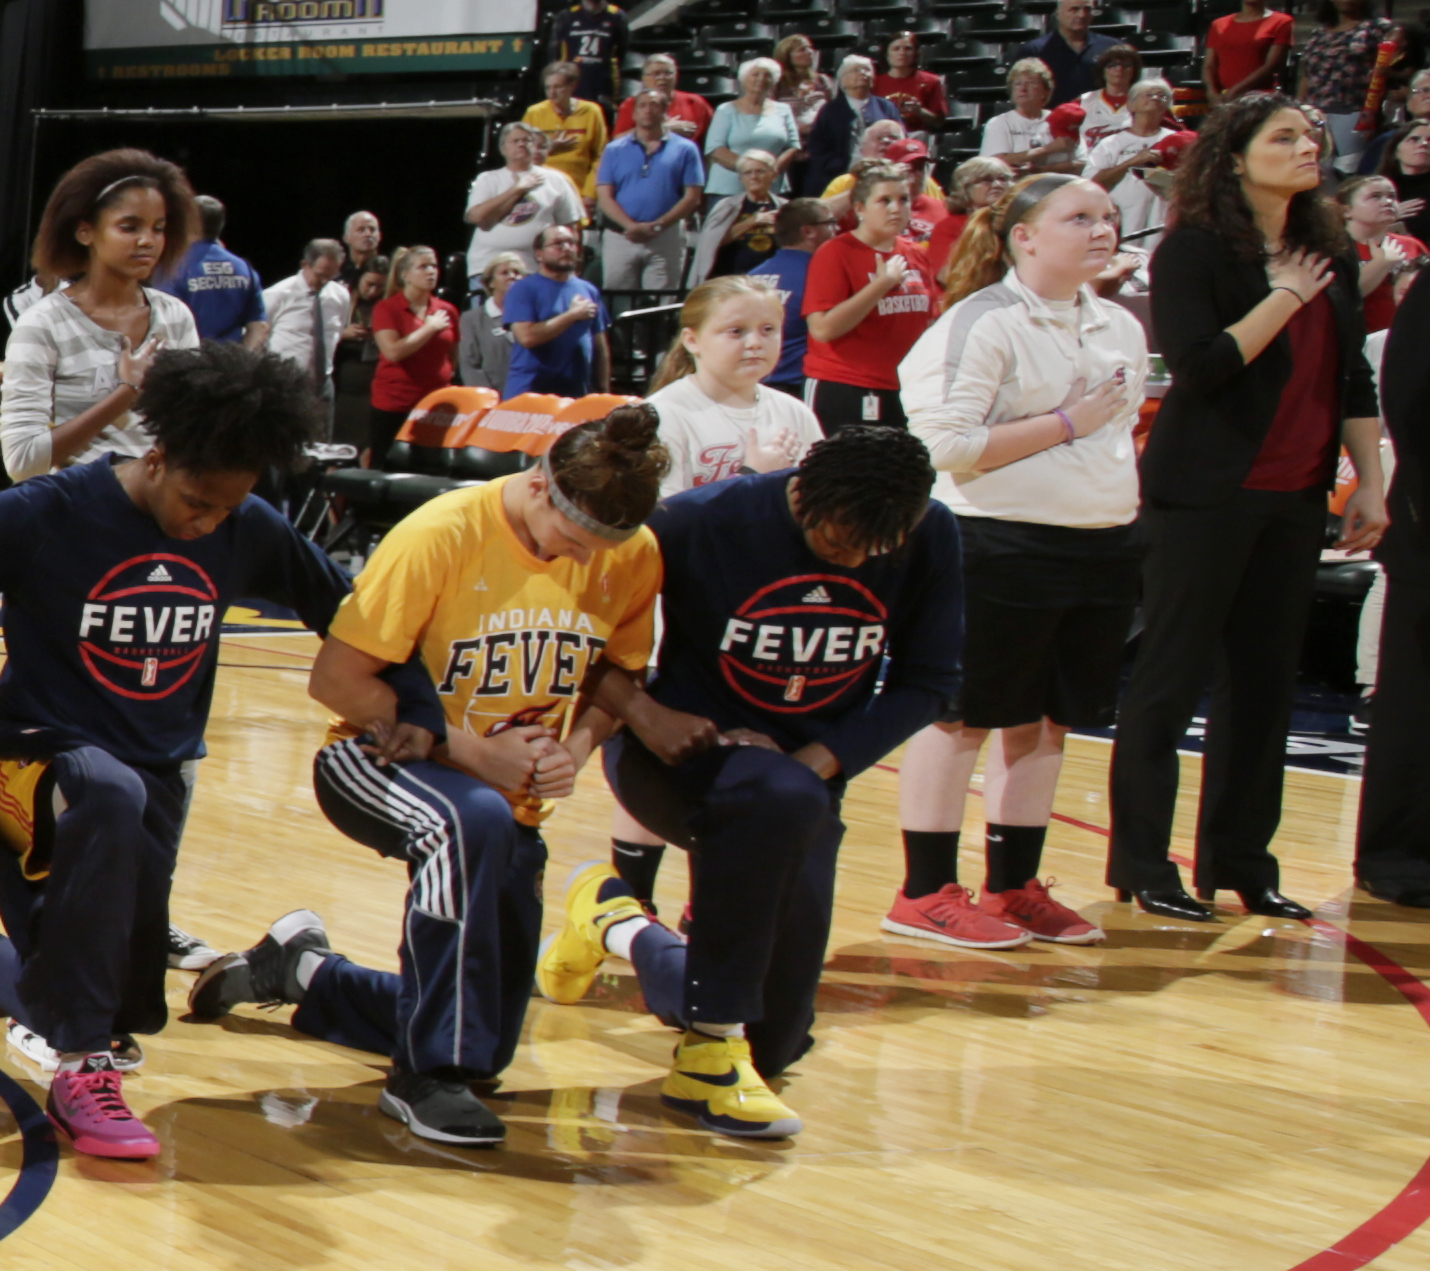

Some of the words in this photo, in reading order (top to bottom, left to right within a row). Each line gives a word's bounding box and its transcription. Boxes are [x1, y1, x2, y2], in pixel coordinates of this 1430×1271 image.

[255, 0, 354, 23] ROOM
[214, 46, 293, 64] LOCKER
[298, 43, 353, 60] ROOM
[359, 39, 503, 58] RESTAURANT
[578, 35, 599, 55] 24
[112, 60, 232, 79] RESTROOMS
[203, 261, 235, 276] ESG
[187, 275, 251, 293] SECURITY
[146, 574, 173, 582] adidas
[802, 595, 832, 604] adidas
[78, 602, 216, 644] FEVER
[480, 607, 594, 633] INDIANA
[719, 618, 885, 664] FEVER
[114, 646, 189, 656] BASKETBALL
[757, 662, 846, 675] BASKETBALL
